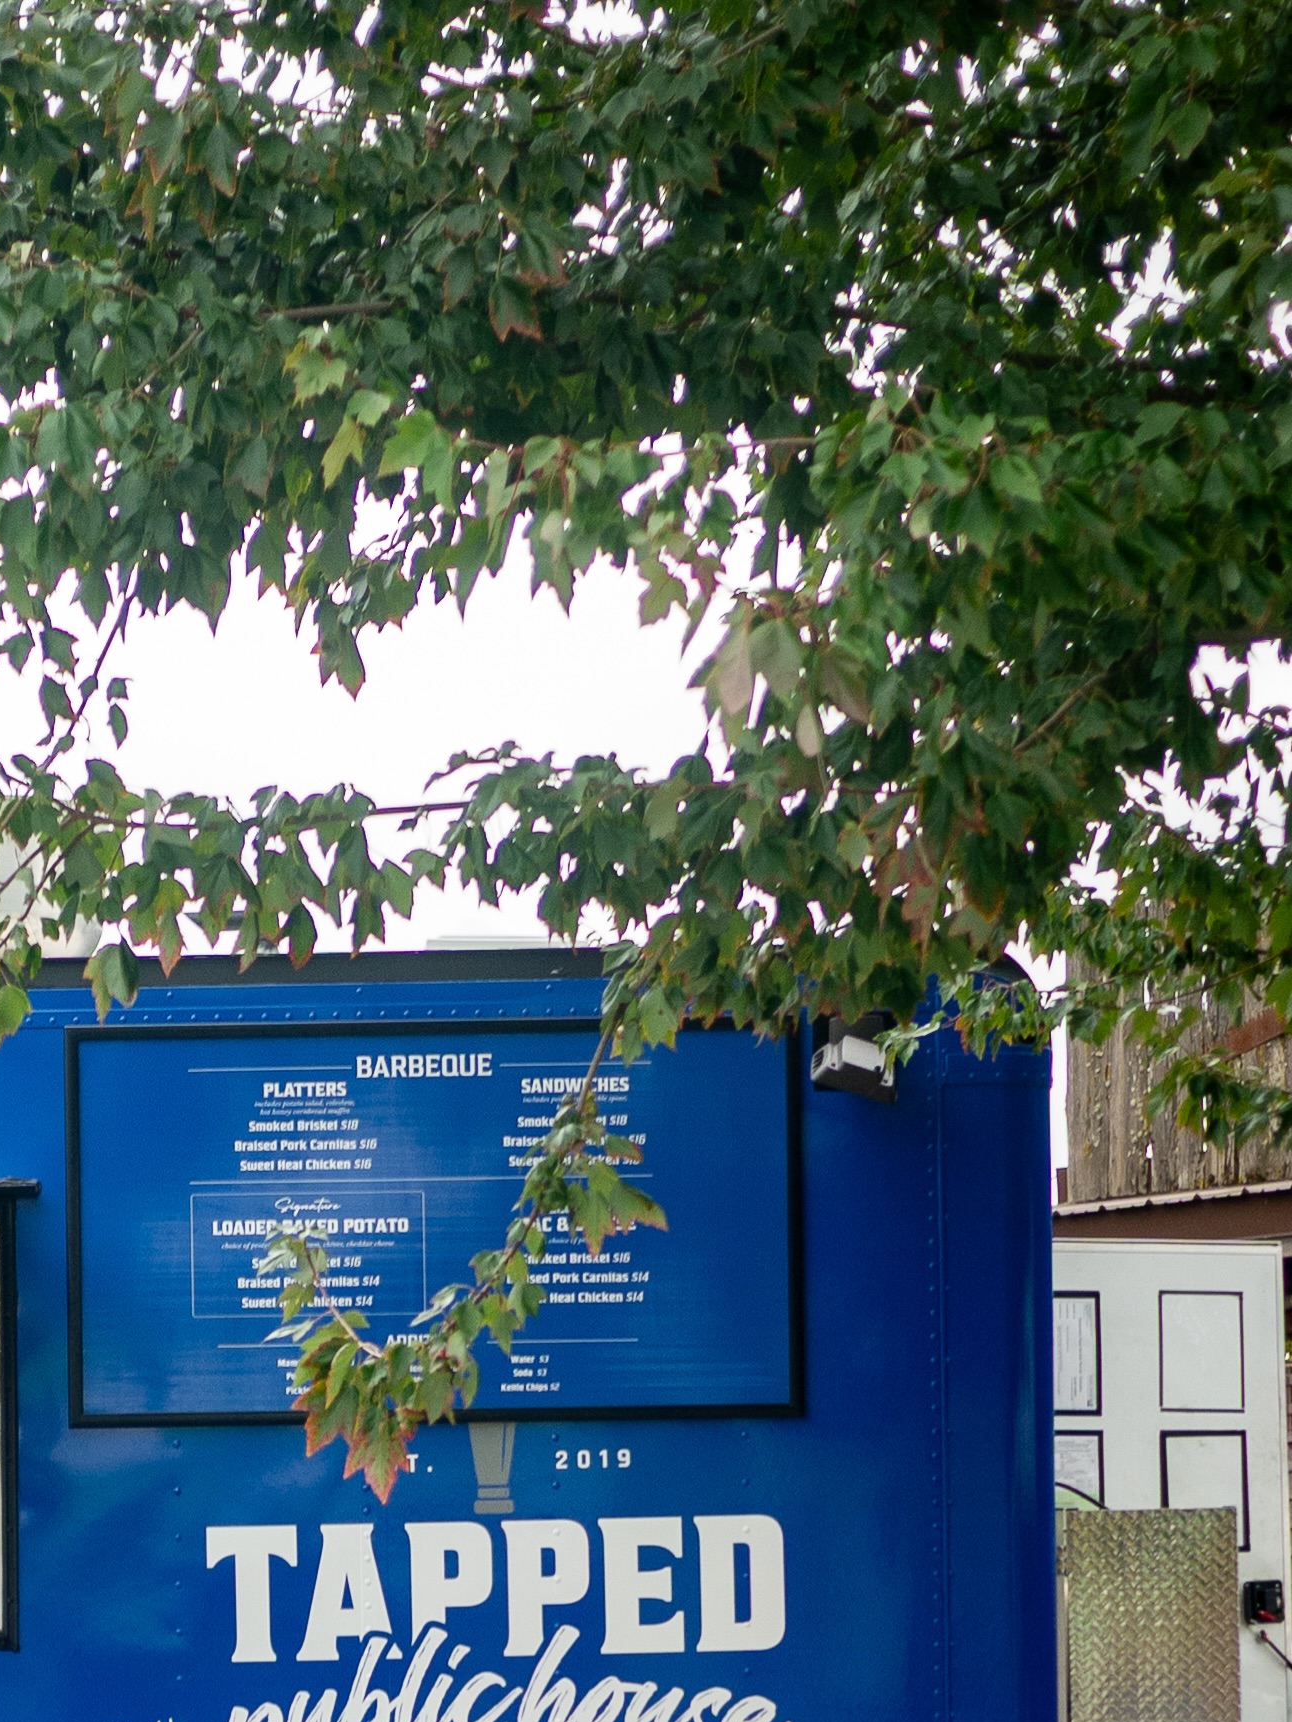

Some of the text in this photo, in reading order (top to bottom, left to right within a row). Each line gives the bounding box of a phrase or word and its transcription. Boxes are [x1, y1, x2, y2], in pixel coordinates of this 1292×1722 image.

[355, 1052, 493, 1079] BARBEQUE
[263, 1081, 348, 1099] PLATTERS
[248, 1119, 295, 1133] Smoked
[296, 1118, 338, 1132] Brisket
[517, 1115, 555, 1128] Smoke
[234, 1139, 278, 1152] Braised
[280, 1138, 308, 1151] Pork
[310, 1138, 357, 1151] Carnitas
[239, 1159, 275, 1172] Sweet
[277, 1158, 303, 1171] Heat
[305, 1158, 352, 1171] Chicken
[273, 1196, 342, 1217] Signature
[343, 1217, 410, 1234] POTATO
[524, 1252, 567, 1265] mked
[569, 1252, 610, 1264] Brisket
[237, 1276, 281, 1289] Braised
[552, 1271, 580, 1284] Pork
[582, 1271, 629, 1284] Carnitas
[241, 1296, 276, 1309] Sweet
[549, 1292, 575, 1304] Heat
[577, 1291, 624, 1304] Chicken
[510, 1354, 536, 1364] Water
[512, 1367, 534, 1378] Soda
[525, 1382, 549, 1393] Chips
[554, 1448, 632, 1470] 2019
[205, 1513, 787, 1663] TAPPED
